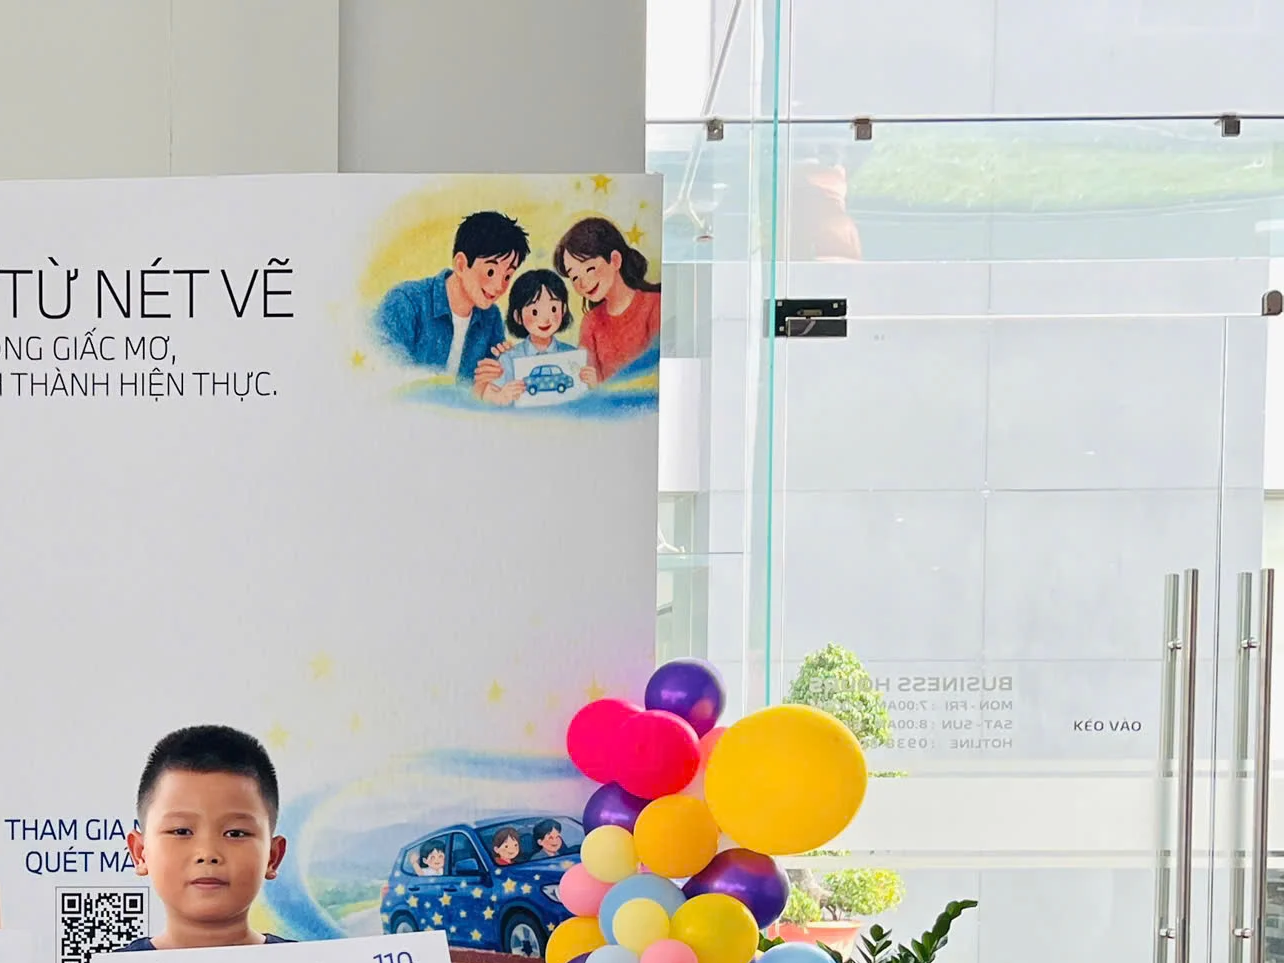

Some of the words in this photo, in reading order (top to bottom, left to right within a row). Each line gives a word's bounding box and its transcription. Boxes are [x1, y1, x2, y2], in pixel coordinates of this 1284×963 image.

[97, 256, 211, 319] NÉT
[220, 257, 295, 319] VẼ
[52, 326, 116, 361] GIẤC
[125, 335, 176, 365] MƠ,
[10, 366, 110, 397] THÀNH
[120, 366, 185, 402] HIỆN
[192, 371, 277, 402] THỰC.
[1073, 716, 1104, 732] KÉO
[4, 818, 78, 841] THAM
[85, 818, 127, 841] GIA
[25, 846, 95, 875] QUÉT
